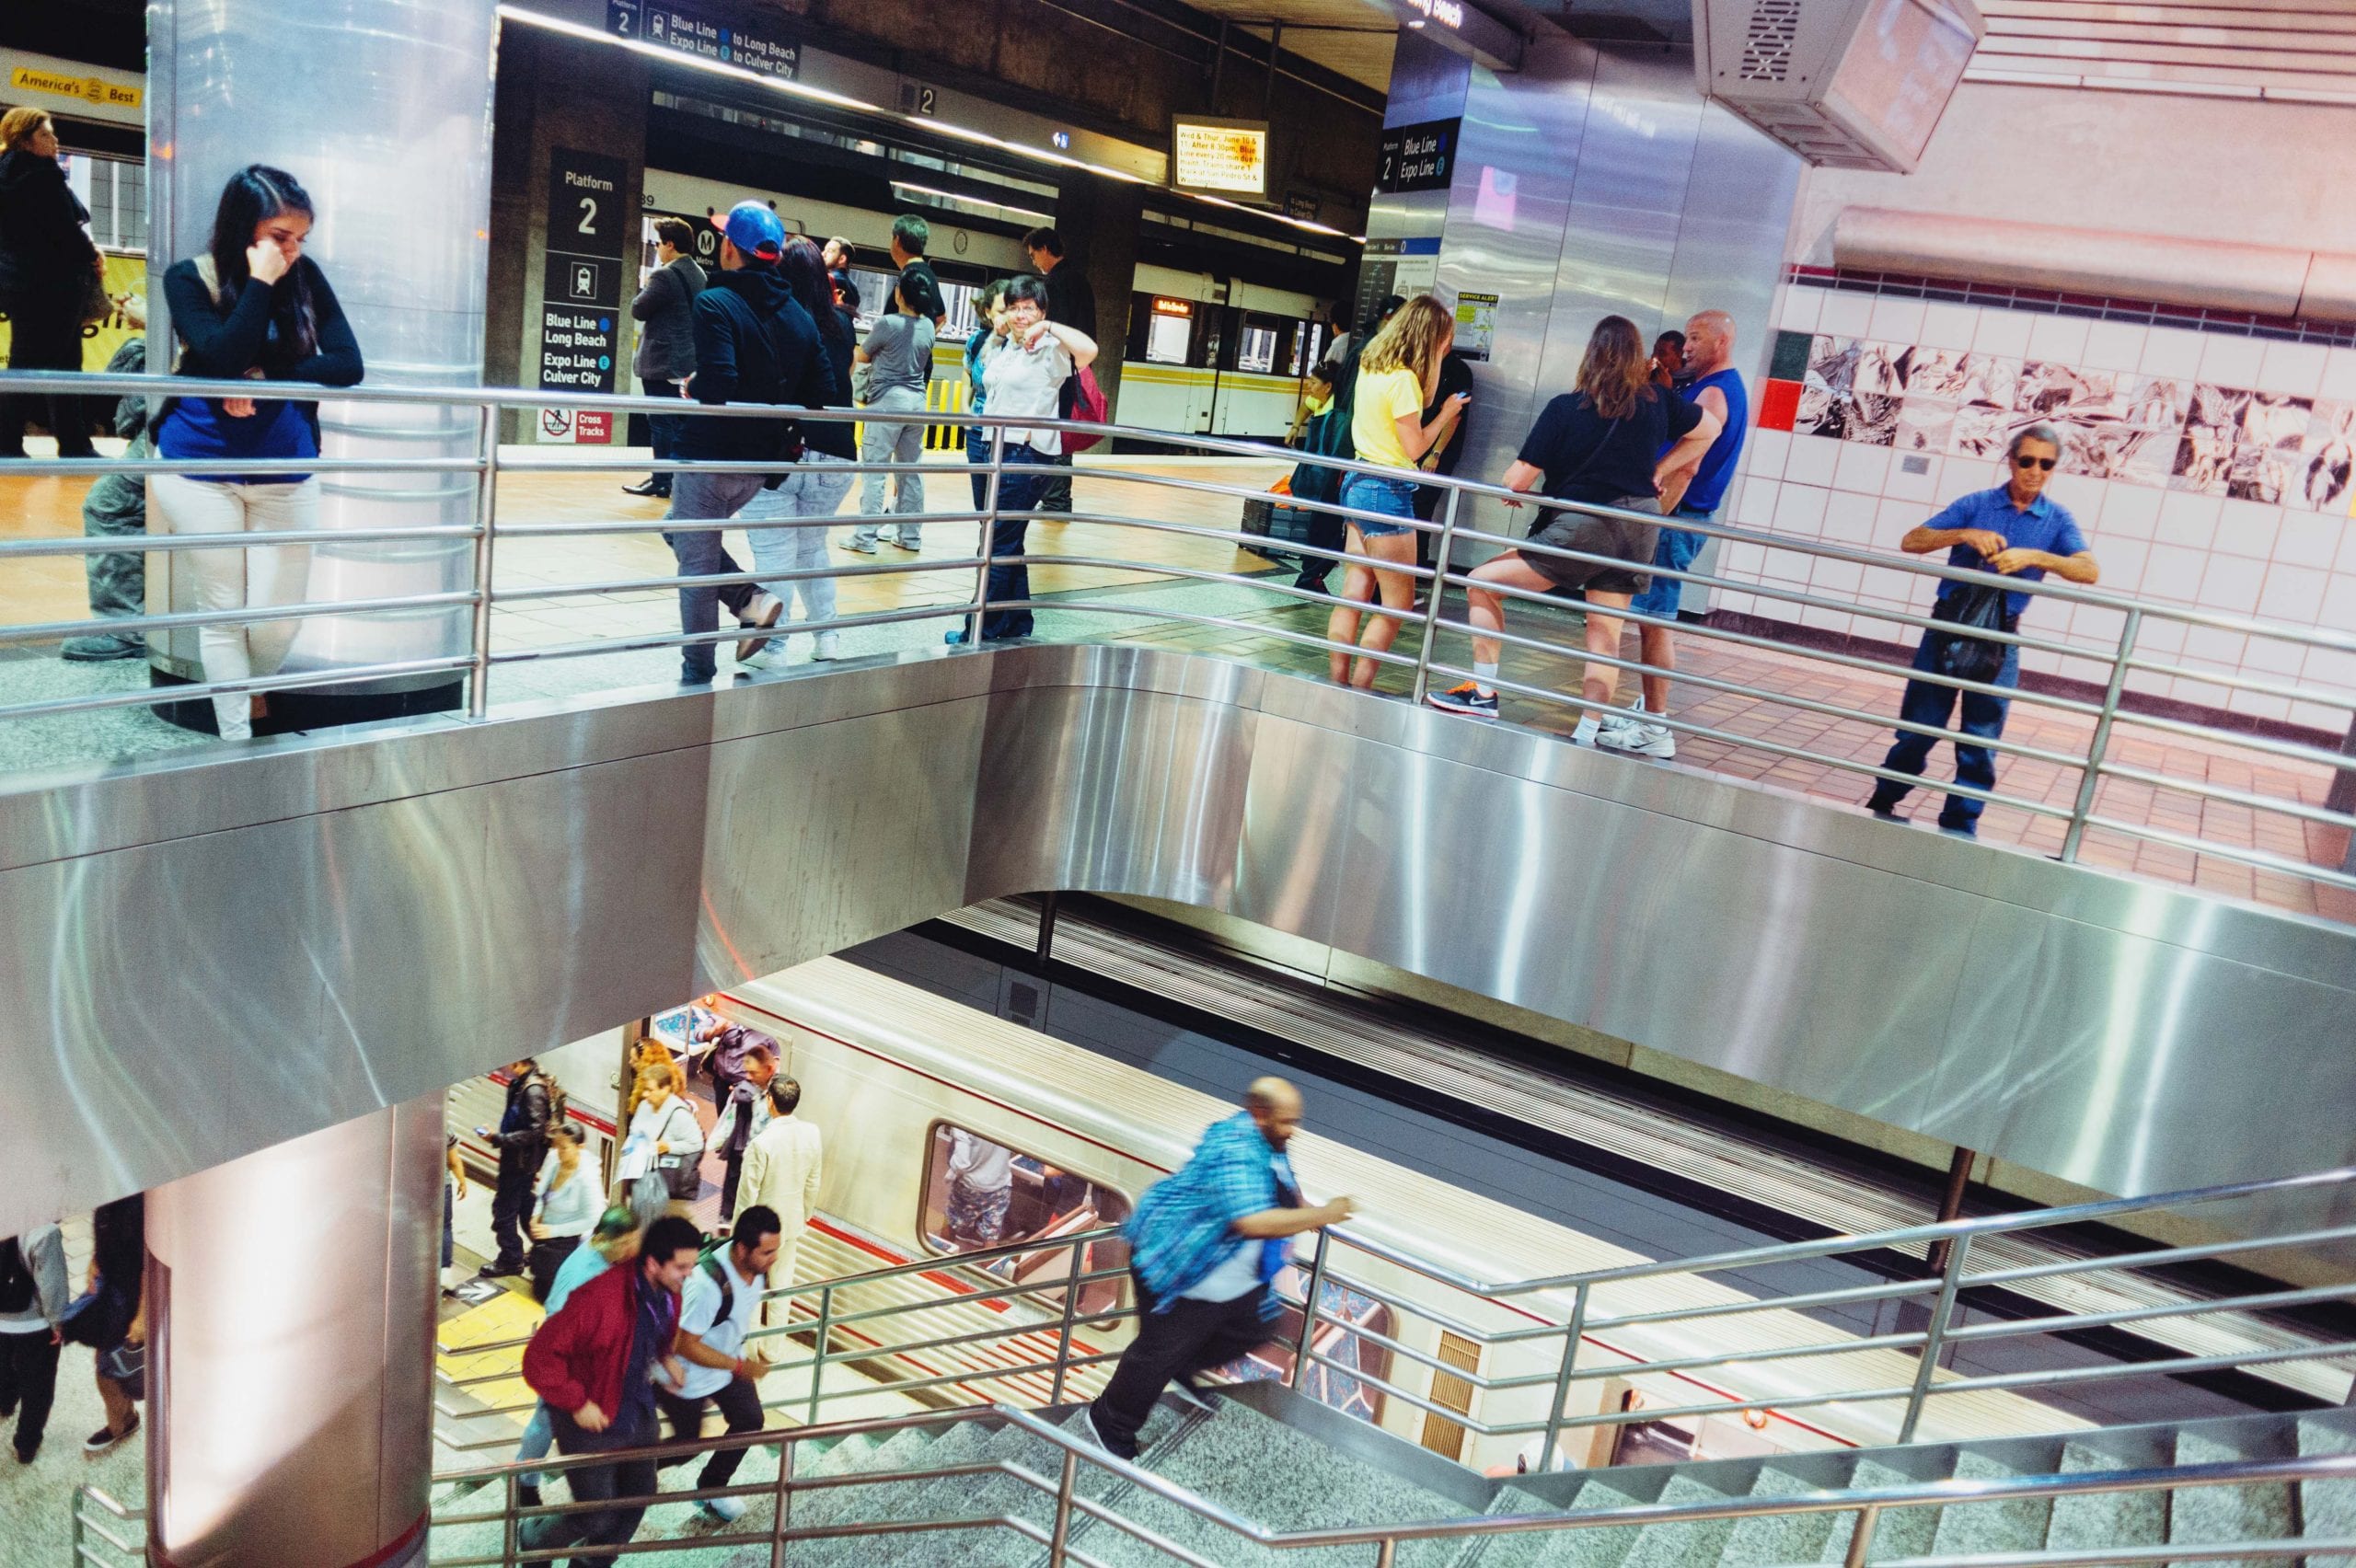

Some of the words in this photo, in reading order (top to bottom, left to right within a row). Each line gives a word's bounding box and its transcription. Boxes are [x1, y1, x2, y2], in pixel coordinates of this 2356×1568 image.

[618, 12, 629, 32] 2
[671, 14, 694, 32] Blue
[696, 22, 717, 39] Line
[733, 32, 743, 45] to
[745, 35, 767, 55] Long
[768, 42, 795, 61] Beach
[670, 32, 695, 52] Expo
[697, 40, 718, 56] Line
[733, 50, 743, 63] to
[745, 53, 774, 71] Culver
[775, 62, 793, 79] City
[19, 73, 80, 94] America's
[109, 88, 134, 103] Best
[921, 88, 933, 113] 2
[1192, 141, 1208, 149] After
[1239, 144, 1256, 155] Blue
[1224, 134, 1241, 144] June
[1404, 138, 1420, 156] Blue
[1421, 135, 1437, 154] Line
[1240, 155, 1253, 163] due
[1254, 156, 1263, 164] to
[1383, 156, 1392, 180] 2
[1400, 162, 1418, 182] Expo
[1419, 159, 1435, 177] Line
[565, 171, 614, 191] Platform
[578, 197, 597, 235] 2
[696, 256, 714, 265] Metro
[546, 313, 572, 328] Blue
[573, 316, 597, 330] Line
[545, 329, 572, 348] Long
[574, 332, 607, 347] Beach
[544, 352, 572, 369] Expo
[573, 354, 597, 368] Line
[543, 369, 579, 384] Culver
[581, 371, 602, 387] City
[579, 414, 602, 424] Cross
[578, 426, 605, 436] Tracks
